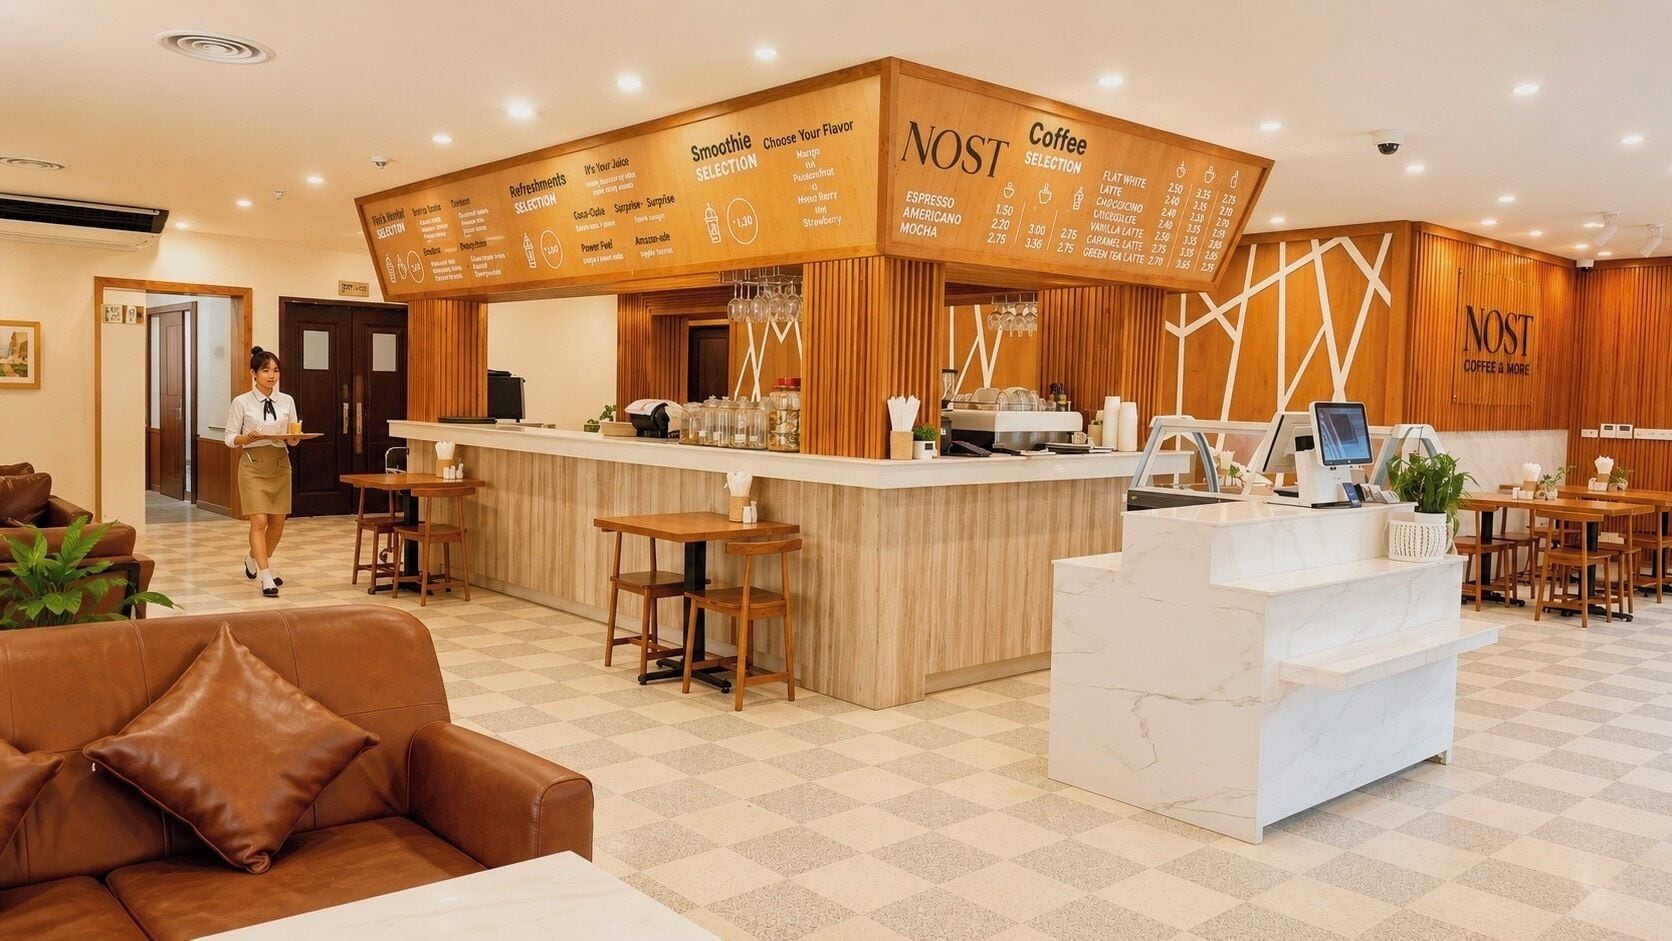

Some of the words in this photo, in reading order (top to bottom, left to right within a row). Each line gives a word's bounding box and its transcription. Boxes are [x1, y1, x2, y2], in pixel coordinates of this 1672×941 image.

[691, 132, 752, 162] Smoothie
[763, 134, 797, 150] Choose
[799, 128, 821, 142] Your
[822, 120, 854, 136] Flavor
[1029, 122, 1087, 155] Coffee
[901, 121, 1010, 178] NOST
[596, 161, 611, 173] Your
[696, 153, 758, 182] SELECTION
[1024, 151, 1082, 174] SELECTION
[509, 172, 567, 198] Refreshments
[1103, 170, 1123, 183] FLAT
[1100, 183, 1123, 197] LATTE
[514, 192, 557, 214] SELECTION
[906, 190, 955, 209] ESPRESSO
[996, 203, 1014, 217] 1.50
[900, 221, 937, 238] MOCHA
[903, 206, 962, 225] AMERICANO
[991, 217, 1010, 231] 2.20
[1121, 227, 1145, 239] LATTE
[1121, 239, 1145, 252] LATTE
[1463, 305, 1534, 357] NOST
[1464, 359, 1496, 373] COFFEE
[1506, 363, 1529, 375] MORE
